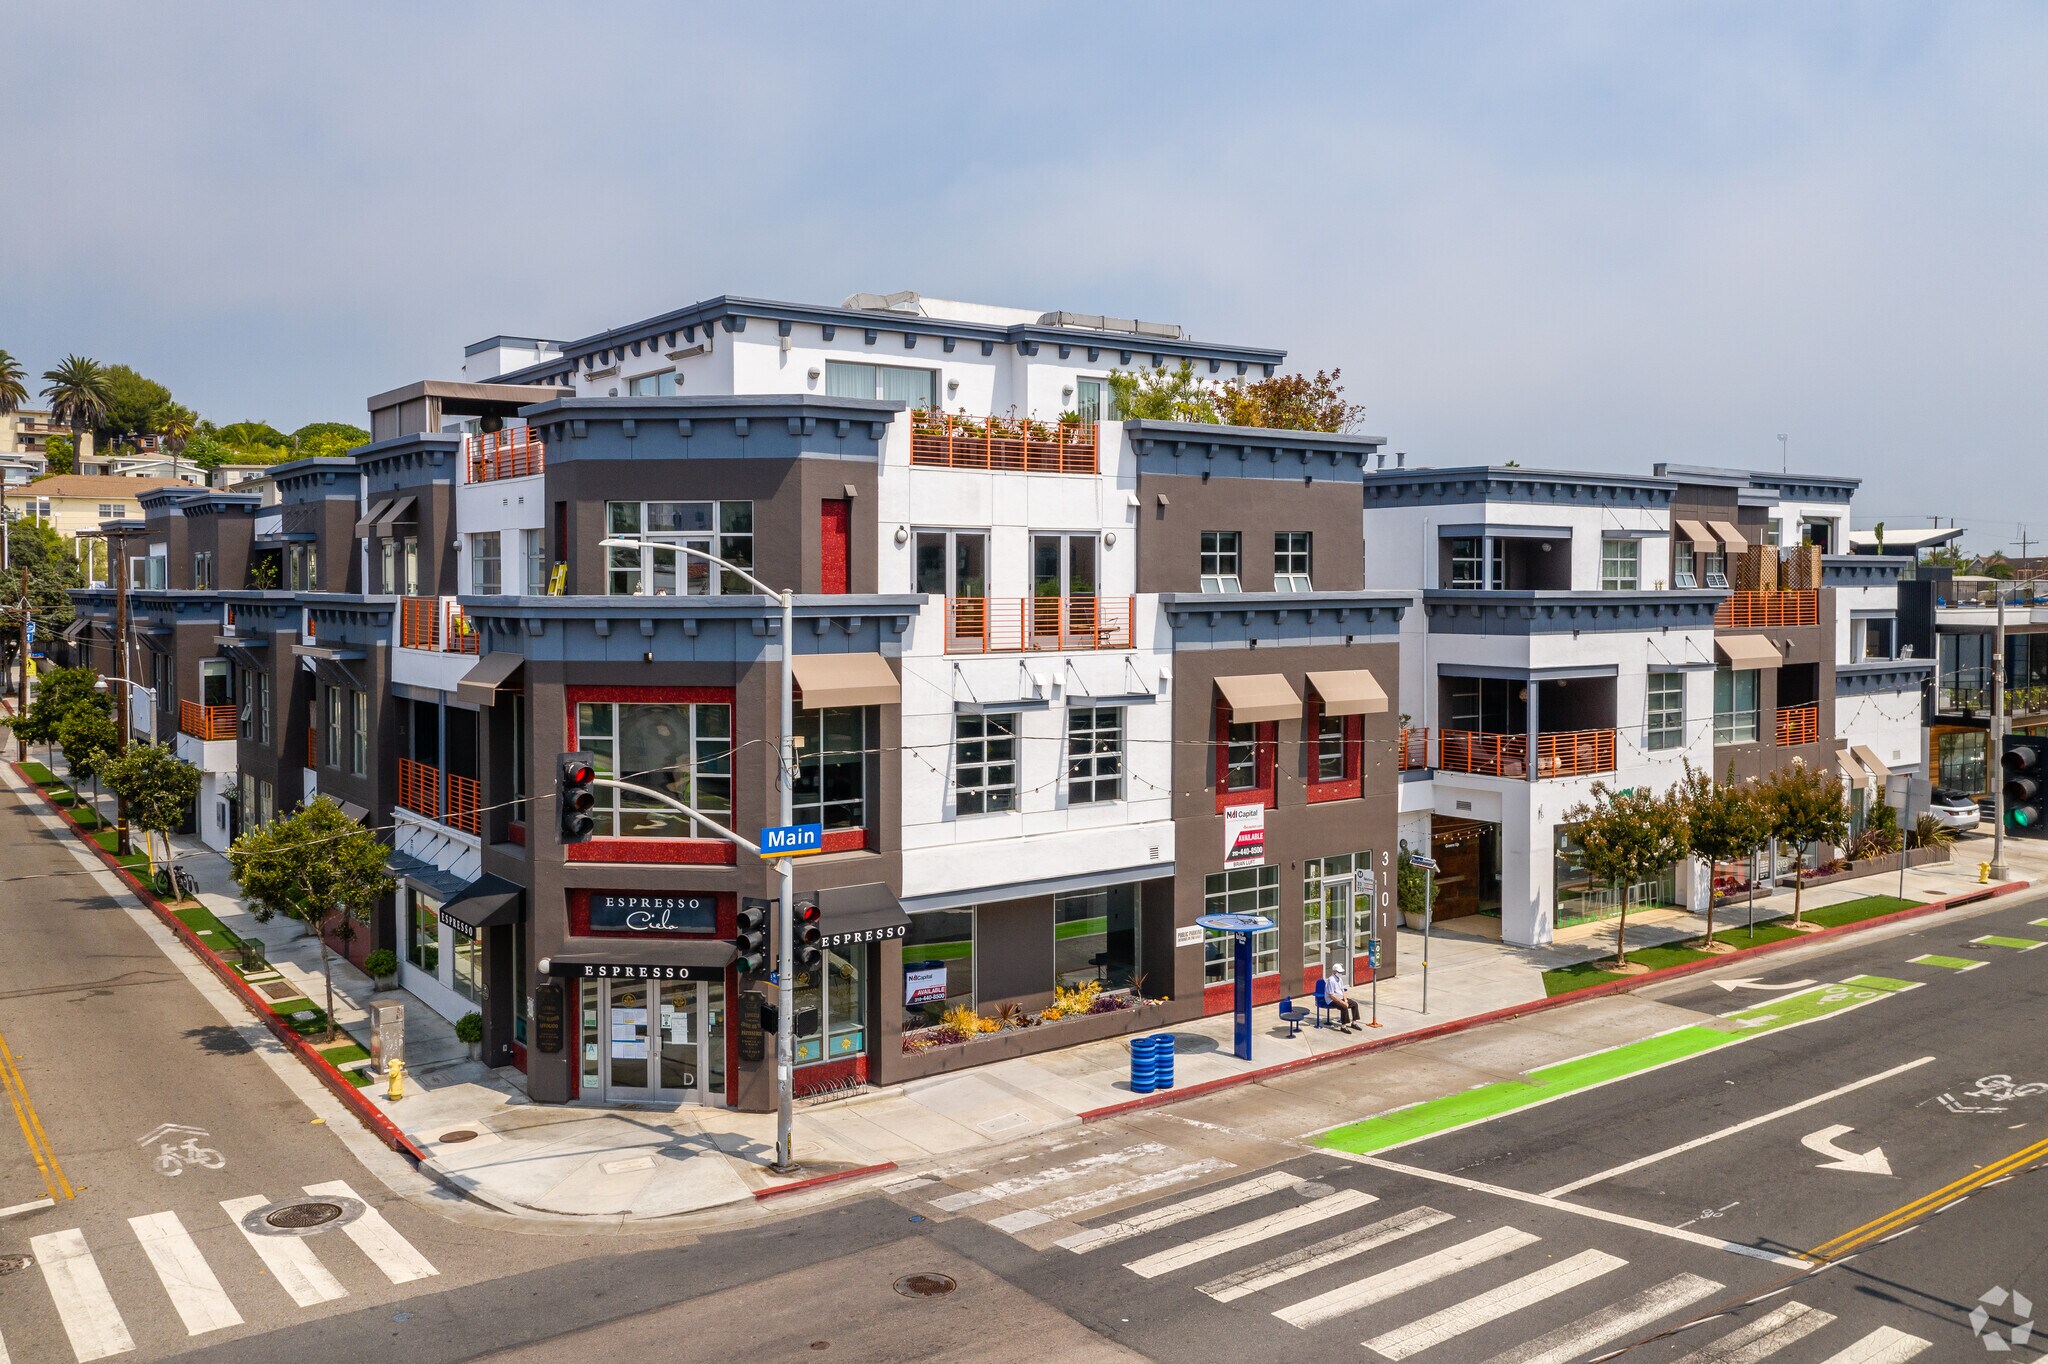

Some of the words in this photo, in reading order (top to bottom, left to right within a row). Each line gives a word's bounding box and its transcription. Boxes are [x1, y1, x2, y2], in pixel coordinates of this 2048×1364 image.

[1238, 809, 1258, 818] Capital
[768, 828, 815, 848] Main
[1238, 832, 1264, 842] AVAILABLE
[1381, 851, 1389, 927] 3101
[606, 897, 700, 909] ESPRESSO
[441, 912, 474, 937] ESPRESSO
[626, 909, 679, 931] Cielo
[821, 926, 906, 947] ESPRESSO
[585, 966, 689, 978] ESPRESSO
[917, 987, 945, 995] AVAILABLE
[588, 1045, 595, 1053] A
[683, 1073, 694, 1085] D
